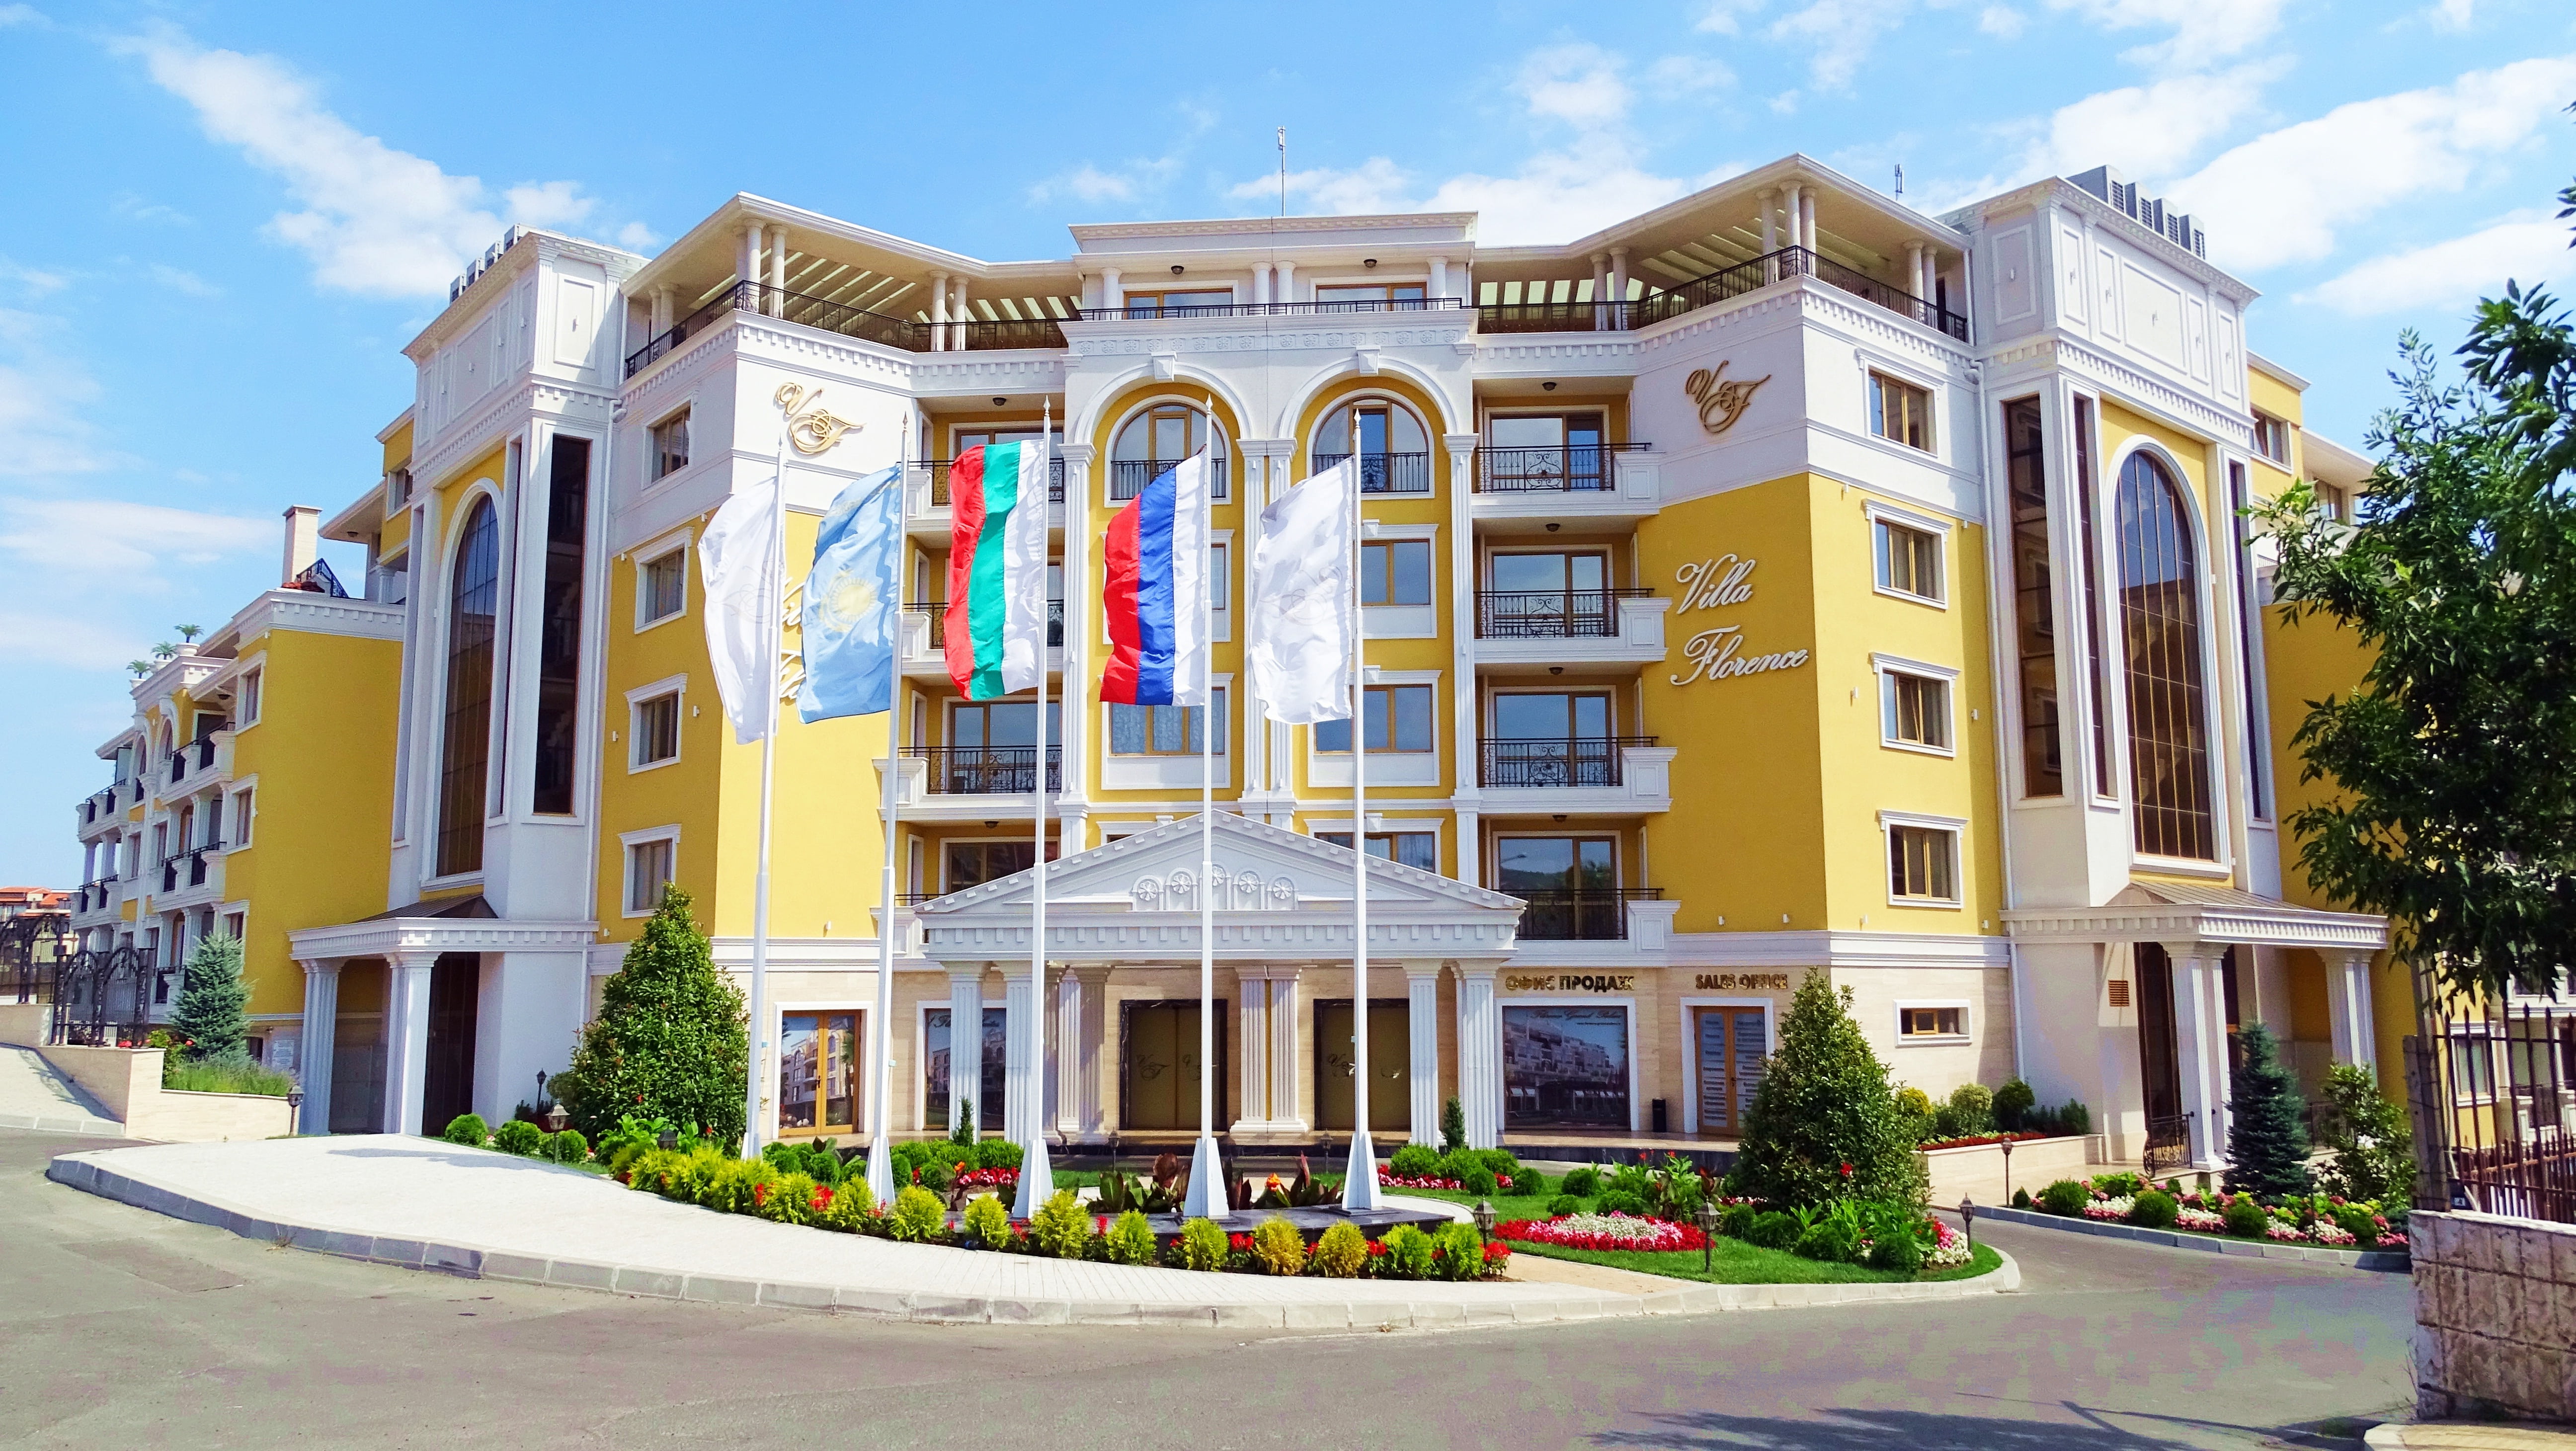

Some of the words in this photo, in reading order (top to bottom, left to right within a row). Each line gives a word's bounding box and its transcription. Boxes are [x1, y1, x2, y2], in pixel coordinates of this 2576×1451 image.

[1676, 553, 1757, 615] Villa
[1670, 624, 1809, 686] Florence
[1506, 974, 1555, 991] ОФИС
[1559, 975, 1635, 993] ПРОДАЖ
[1695, 974, 1736, 990] SALES
[1739, 974, 1788, 990] OFFICE
